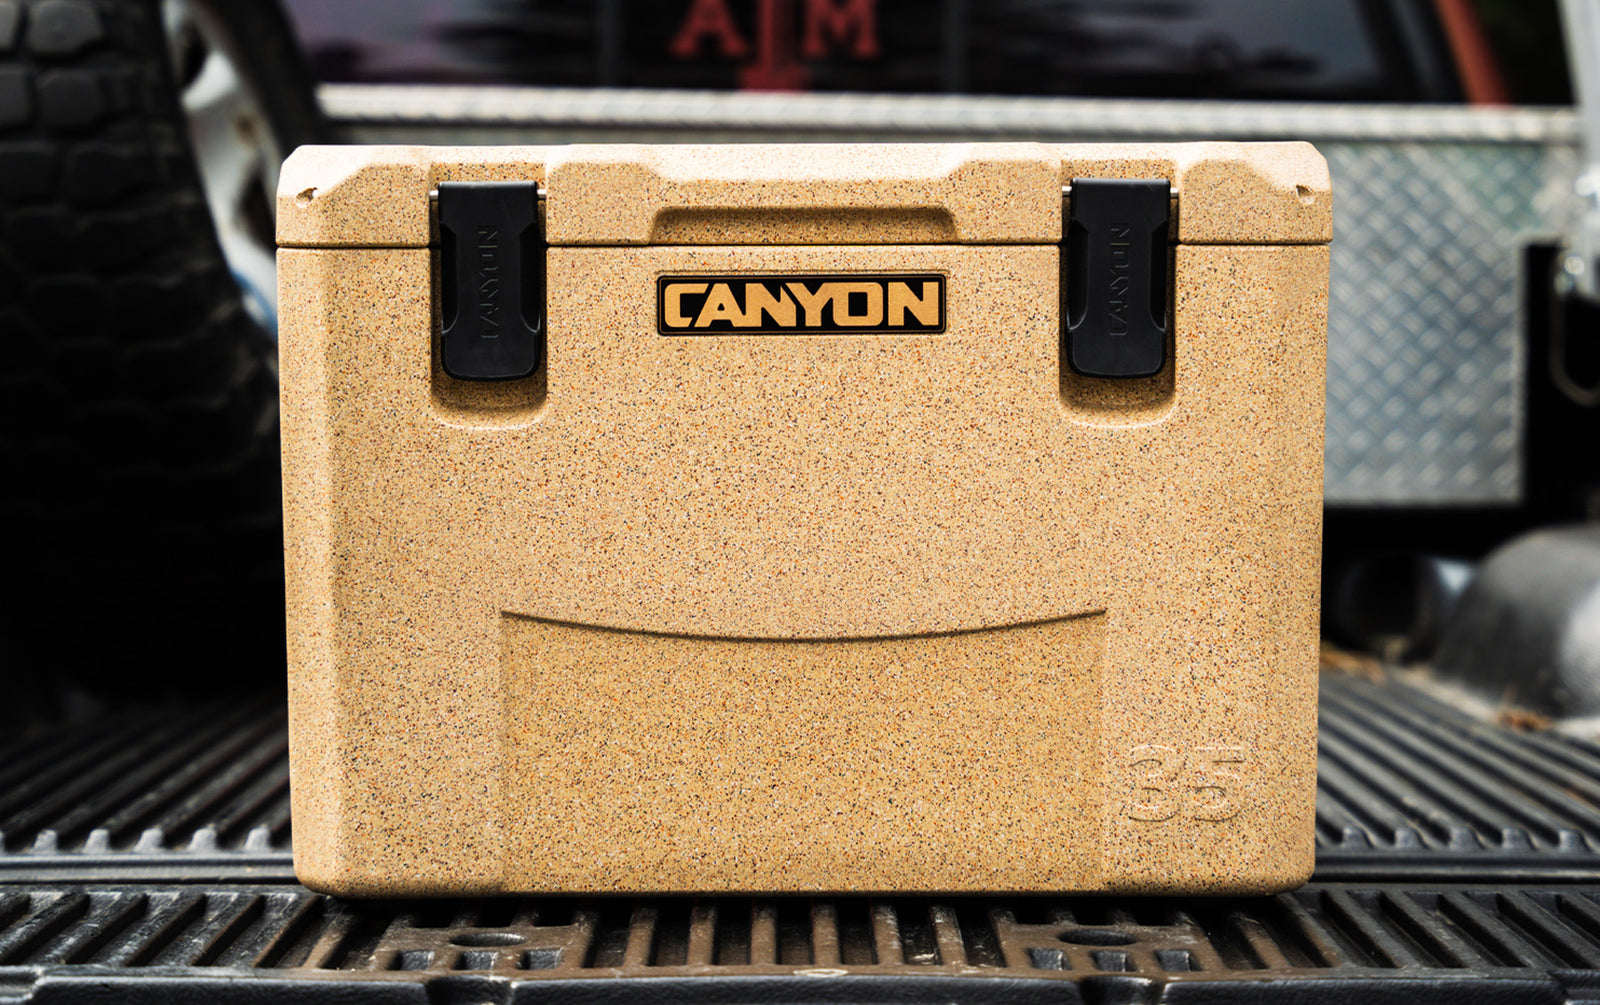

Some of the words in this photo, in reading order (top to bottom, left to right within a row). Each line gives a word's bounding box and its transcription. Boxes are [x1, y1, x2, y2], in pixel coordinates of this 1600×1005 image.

[478, 224, 500, 339] CANYON
[664, 281, 940, 328] CANYON
[1109, 222, 1131, 337] CANYON
[1120, 744, 1245, 822] 35
